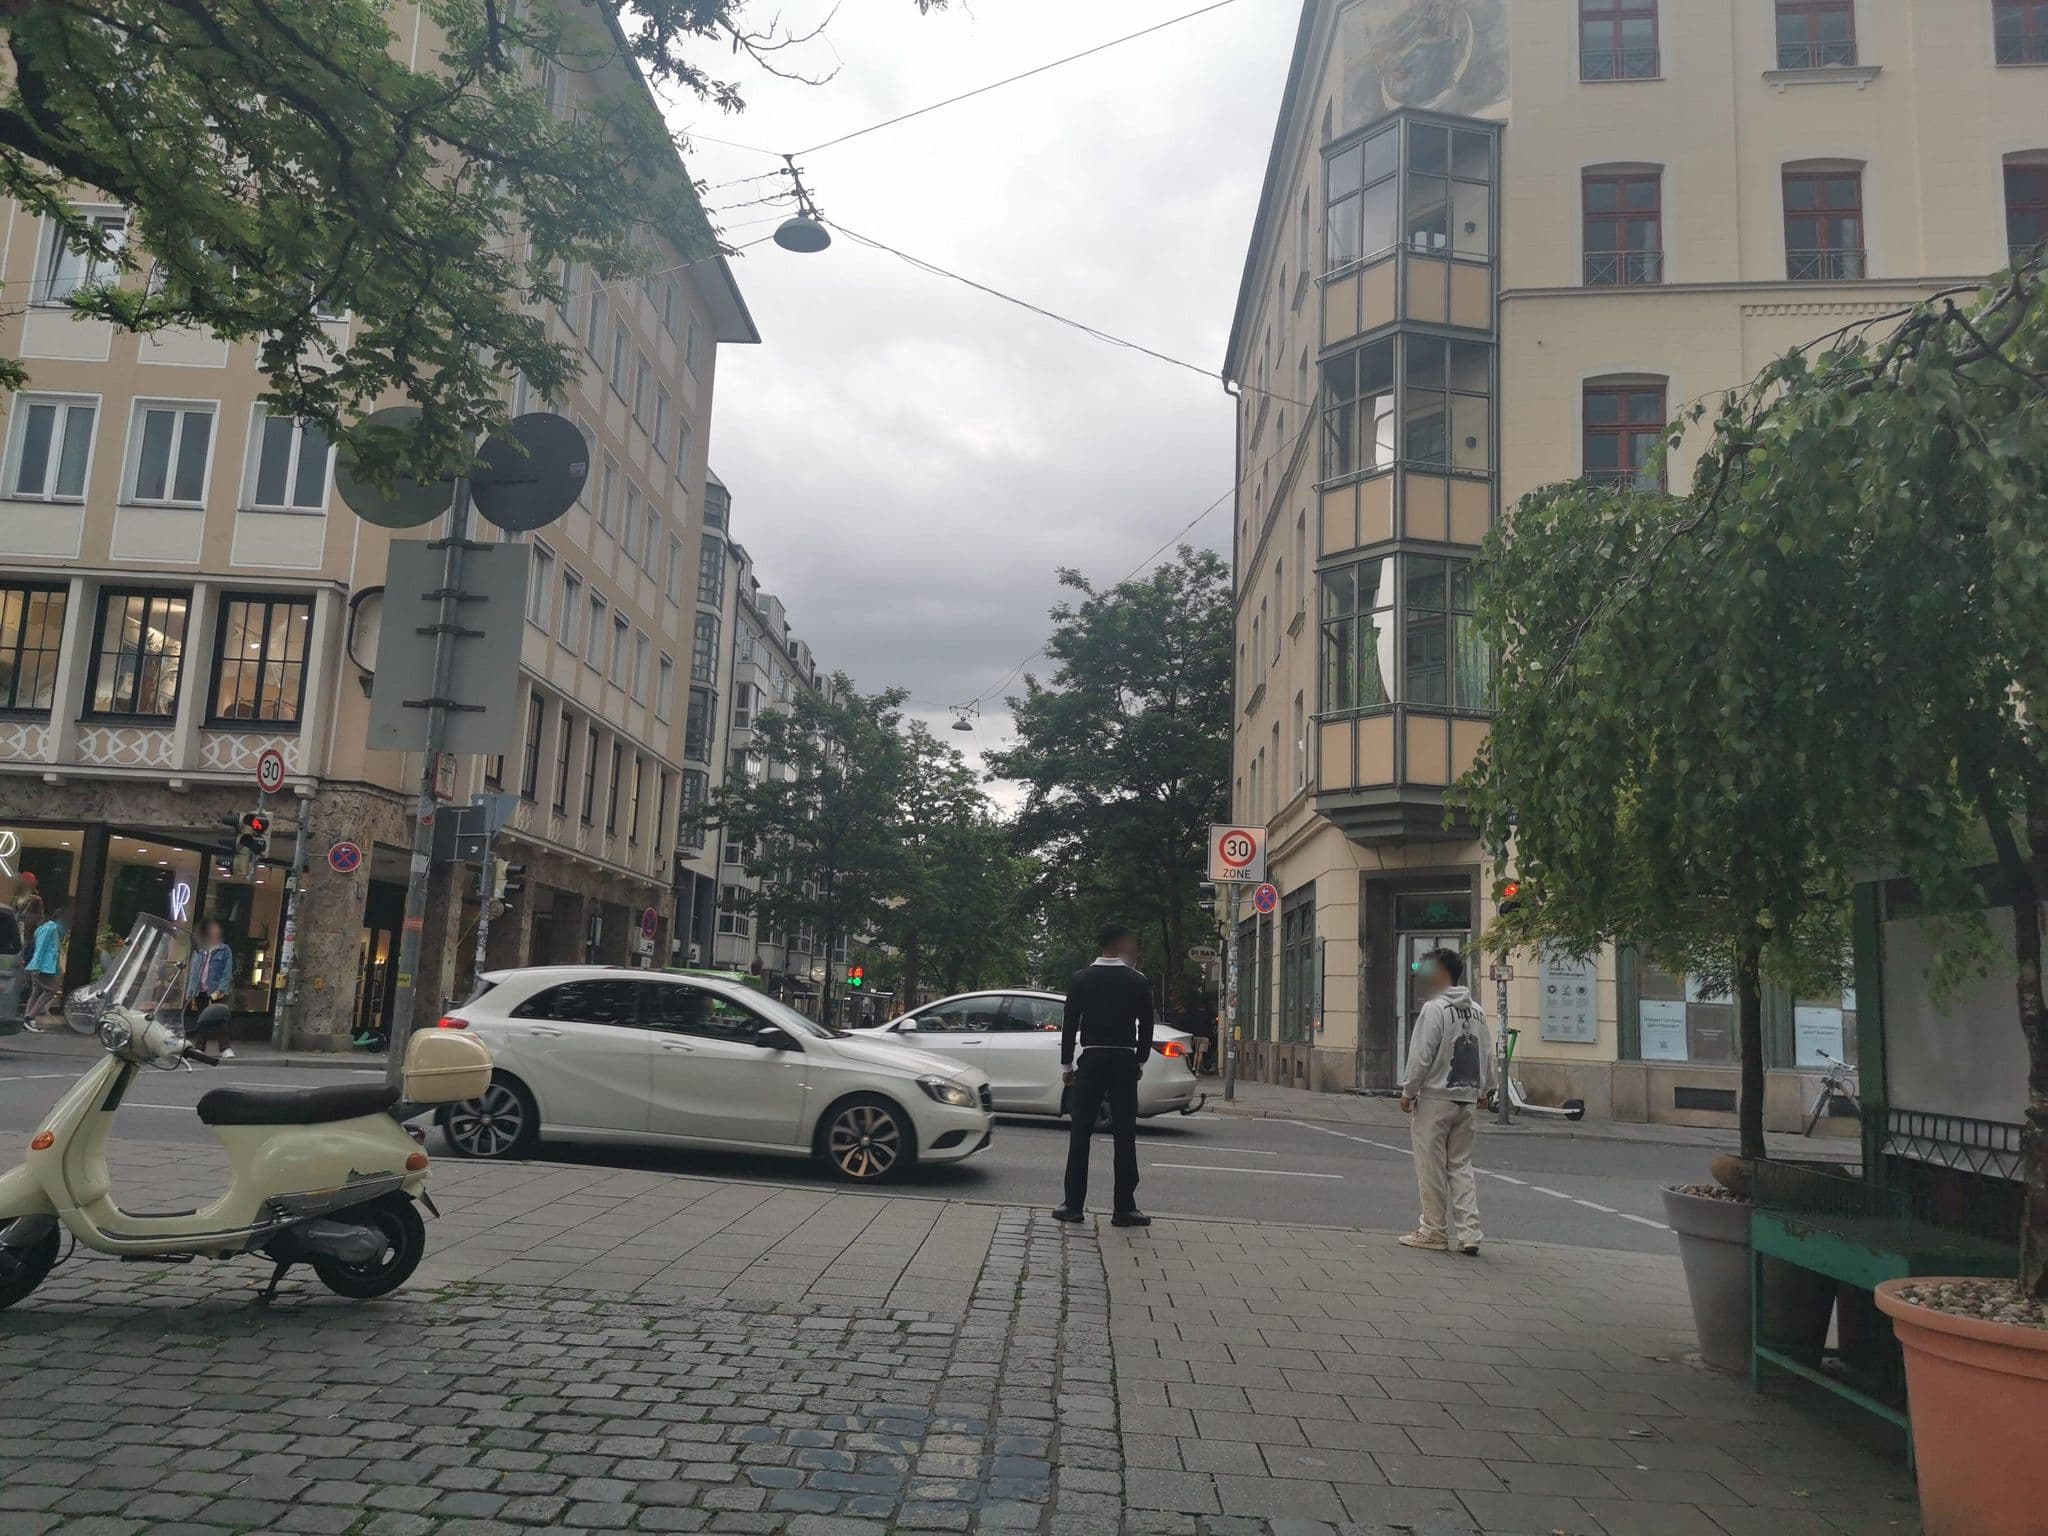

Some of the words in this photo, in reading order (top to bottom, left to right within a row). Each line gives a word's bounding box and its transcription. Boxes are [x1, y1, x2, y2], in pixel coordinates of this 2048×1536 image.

[262, 759, 280, 781] 30
[1227, 840, 1248, 857] 30
[1222, 868, 1252, 879] ZONE
